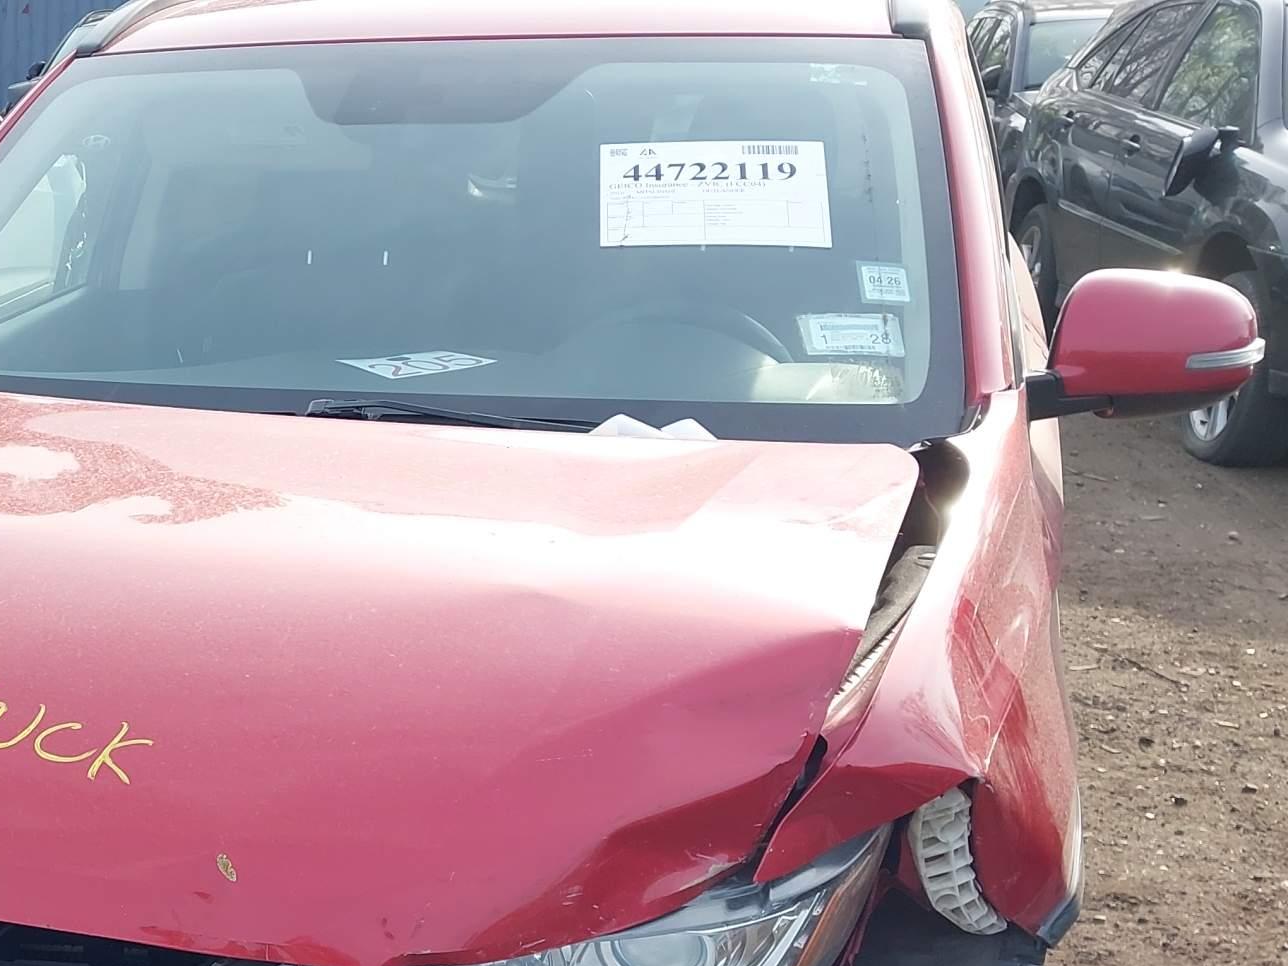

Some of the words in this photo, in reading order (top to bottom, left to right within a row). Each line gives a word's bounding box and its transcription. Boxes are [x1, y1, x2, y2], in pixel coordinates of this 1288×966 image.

[622, 162, 797, 182] 44722119
[868, 275, 883, 285] 04
[886, 276, 901, 286] 26
[368, 354, 483, 378] 205
